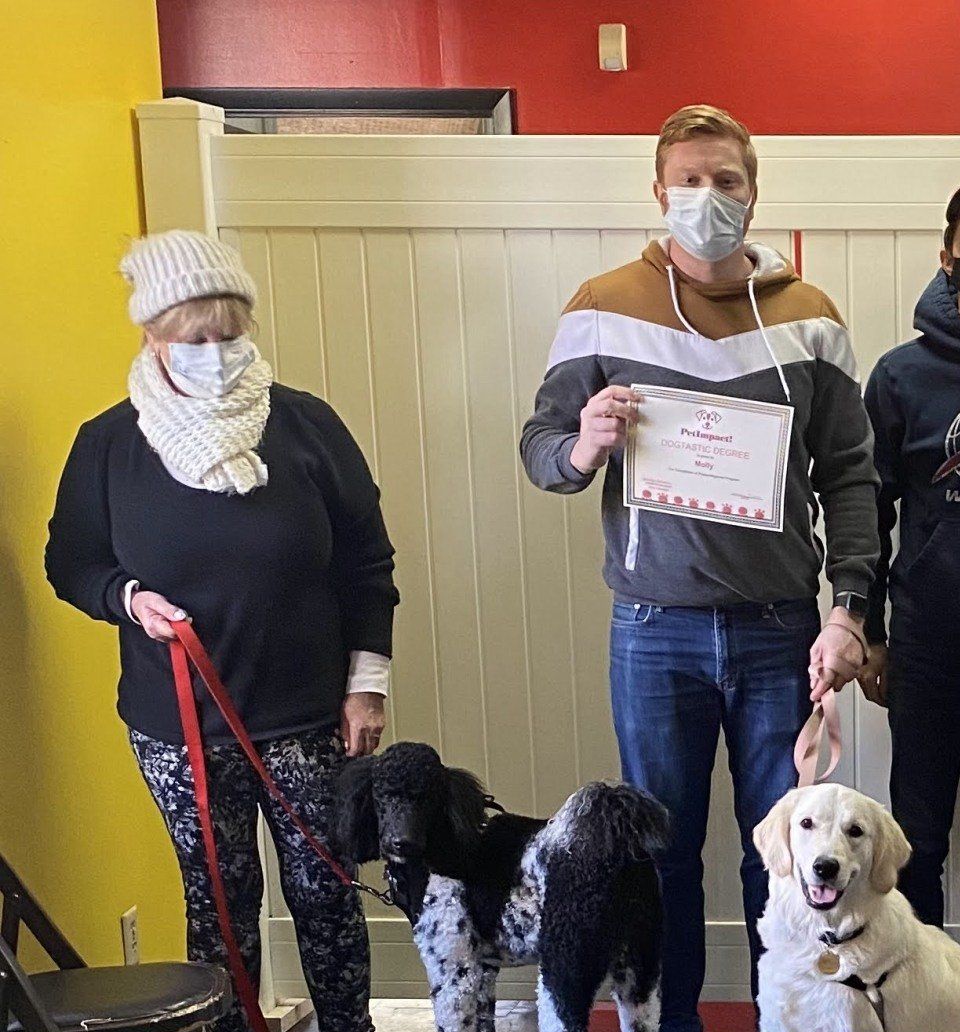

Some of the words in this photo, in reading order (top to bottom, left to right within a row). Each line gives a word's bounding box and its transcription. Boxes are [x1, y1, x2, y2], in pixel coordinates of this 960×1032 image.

[661, 439, 711, 454] DOGTASTIC
[713, 446, 750, 460] DEGREE
[694, 460, 714, 471] Molly
